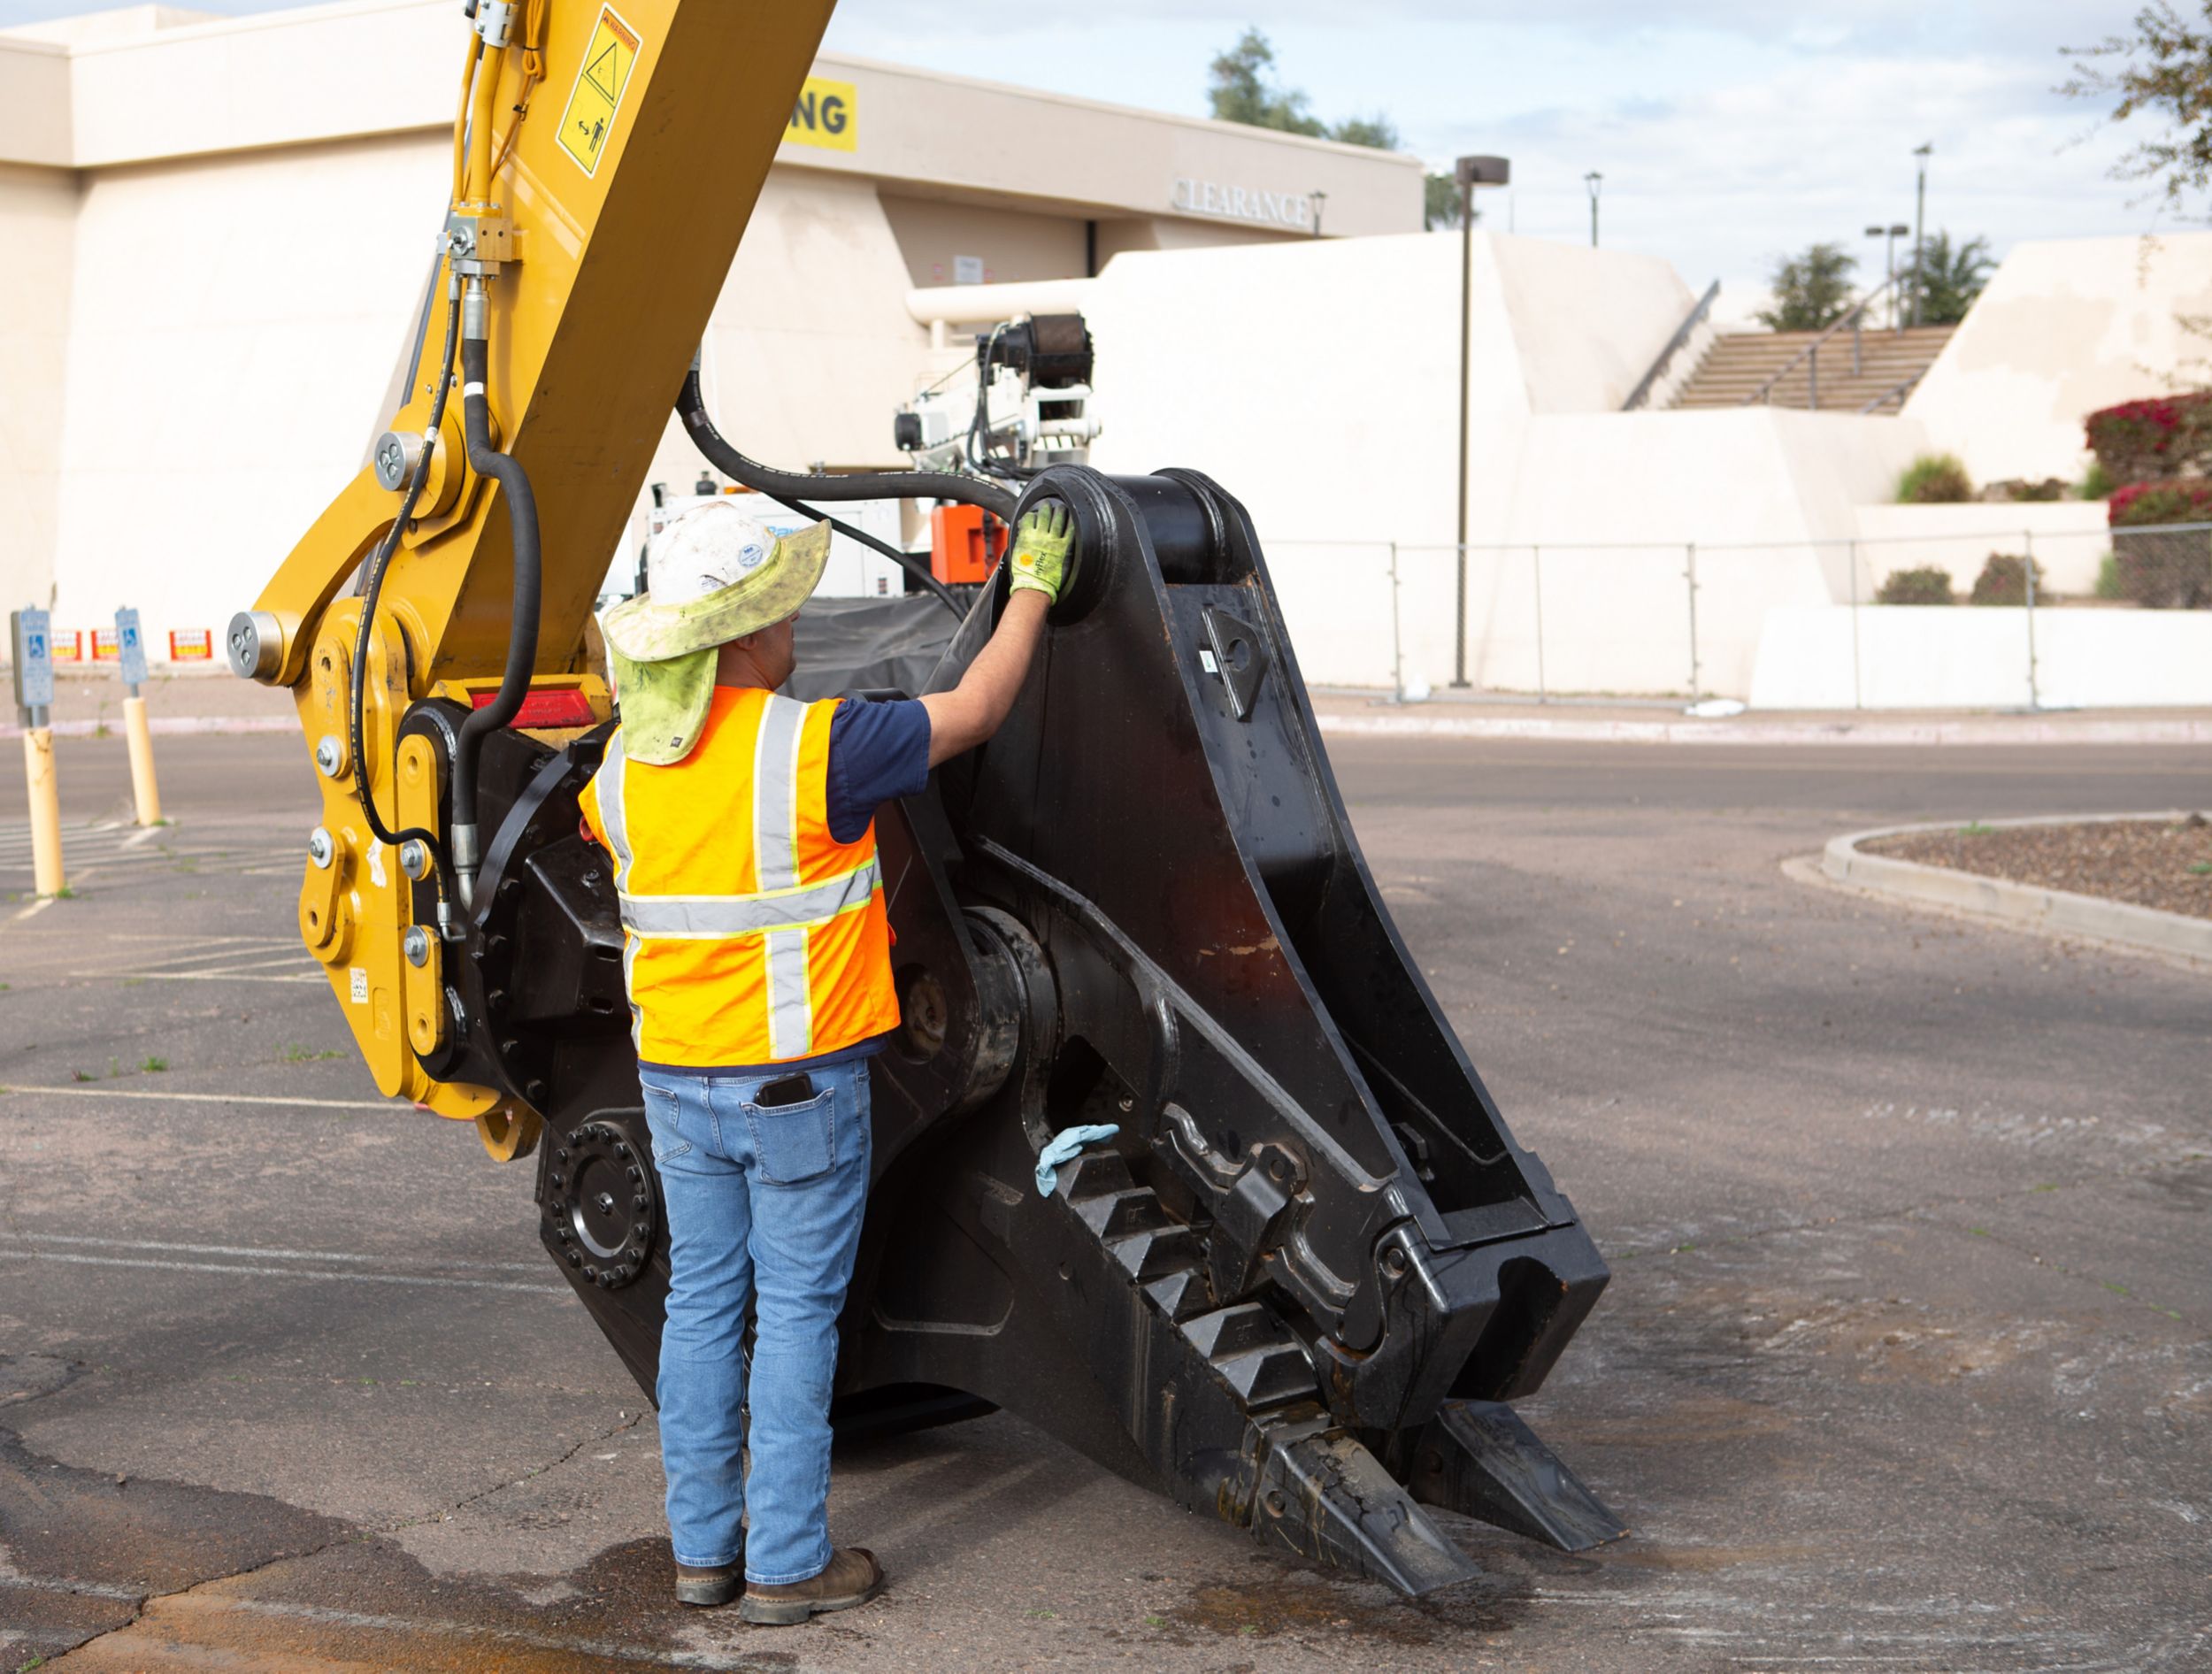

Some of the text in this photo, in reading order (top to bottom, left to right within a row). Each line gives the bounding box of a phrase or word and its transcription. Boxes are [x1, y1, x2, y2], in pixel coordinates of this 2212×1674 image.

[609, 20, 636, 51] WARNING
[1169, 177, 1309, 227] CLEARANCE
[1033, 551, 1048, 577] HyFlex
